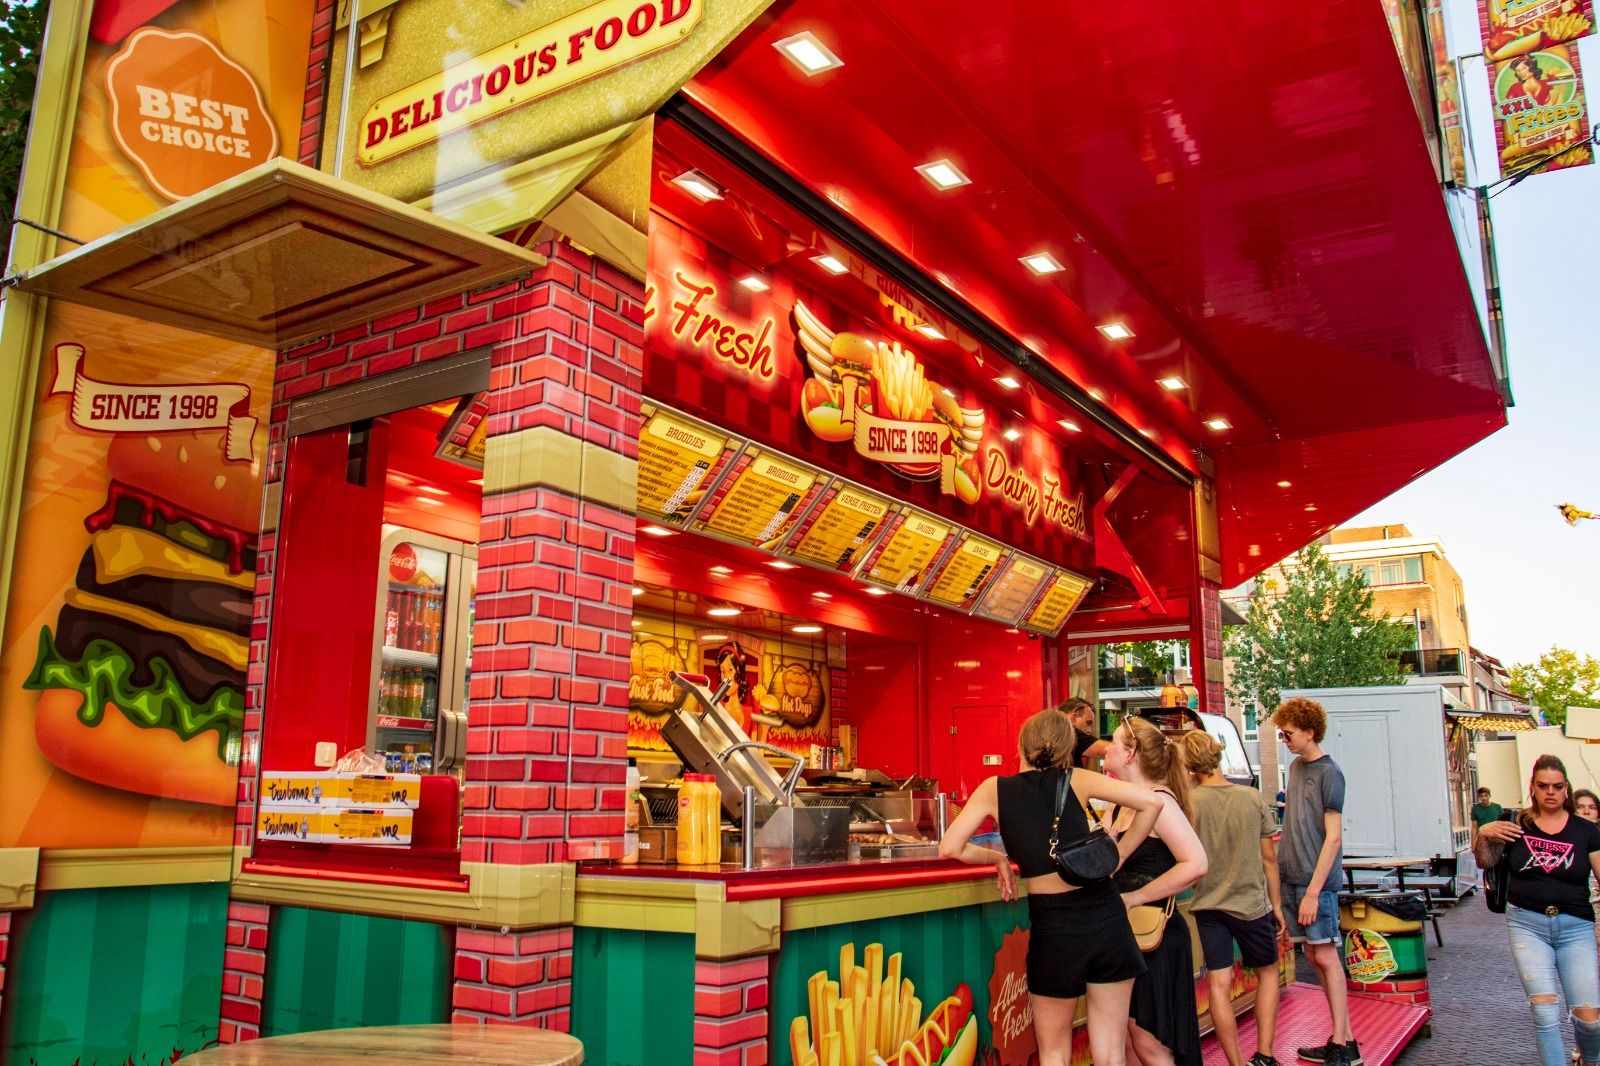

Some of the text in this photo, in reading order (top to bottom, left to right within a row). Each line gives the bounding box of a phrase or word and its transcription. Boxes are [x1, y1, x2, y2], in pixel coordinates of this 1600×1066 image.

[365, 0, 692, 149] DELICIOUS FOOD
[137, 84, 249, 134] BEST
[1499, 99, 1534, 116] XXL
[1510, 103, 1580, 131] Frites
[139, 120, 252, 159] CHOICE
[672, 272, 774, 379] Fresh
[90, 394, 218, 420] SINCE 1998
[665, 426, 706, 450] BROODJES
[867, 427, 938, 454] SINCE 1998
[765, 465, 800, 484] BROODJES
[986, 447, 1085, 535] Dairy Fresh
[630, 674, 675, 704] Fast Food
[782, 695, 813, 717] Hot Dogs
[1530, 840, 1565, 853] GUESS
[1350, 959, 1394, 977] Frites
[993, 971, 1029, 1022] Alwa
